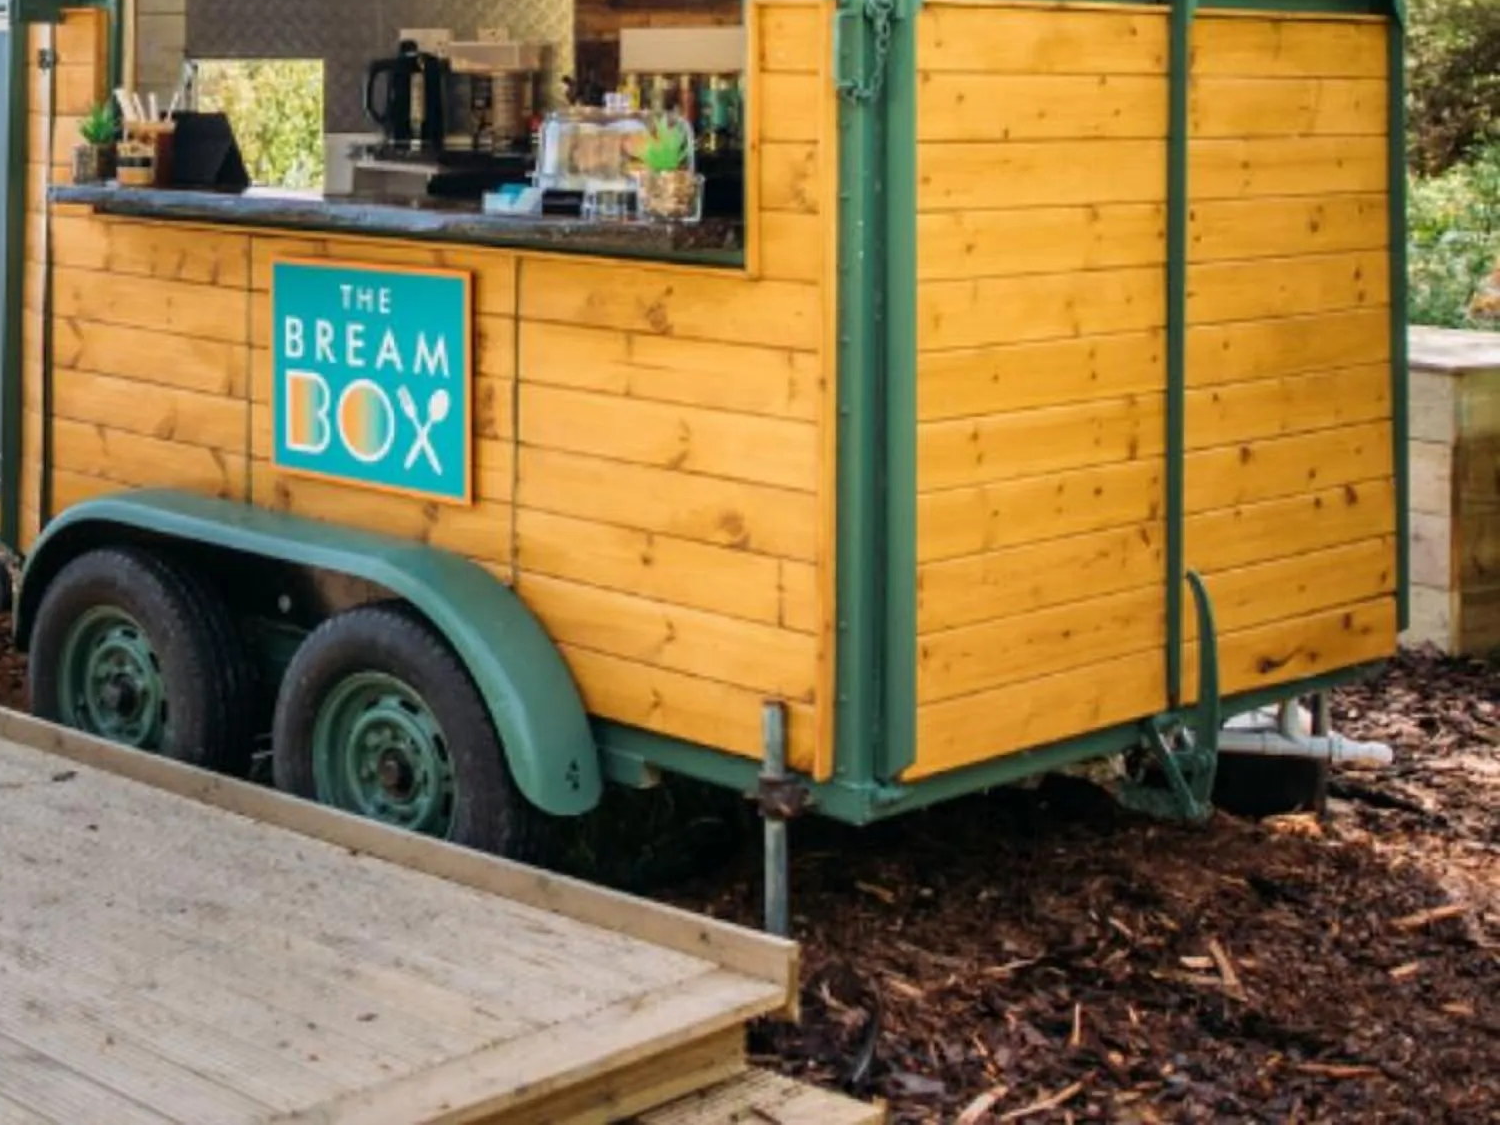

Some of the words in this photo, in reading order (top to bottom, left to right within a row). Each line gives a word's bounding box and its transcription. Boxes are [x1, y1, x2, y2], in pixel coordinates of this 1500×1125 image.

[340, 284, 392, 314] THE
[285, 315, 450, 378] BREAM
[285, 369, 450, 476] BOX
